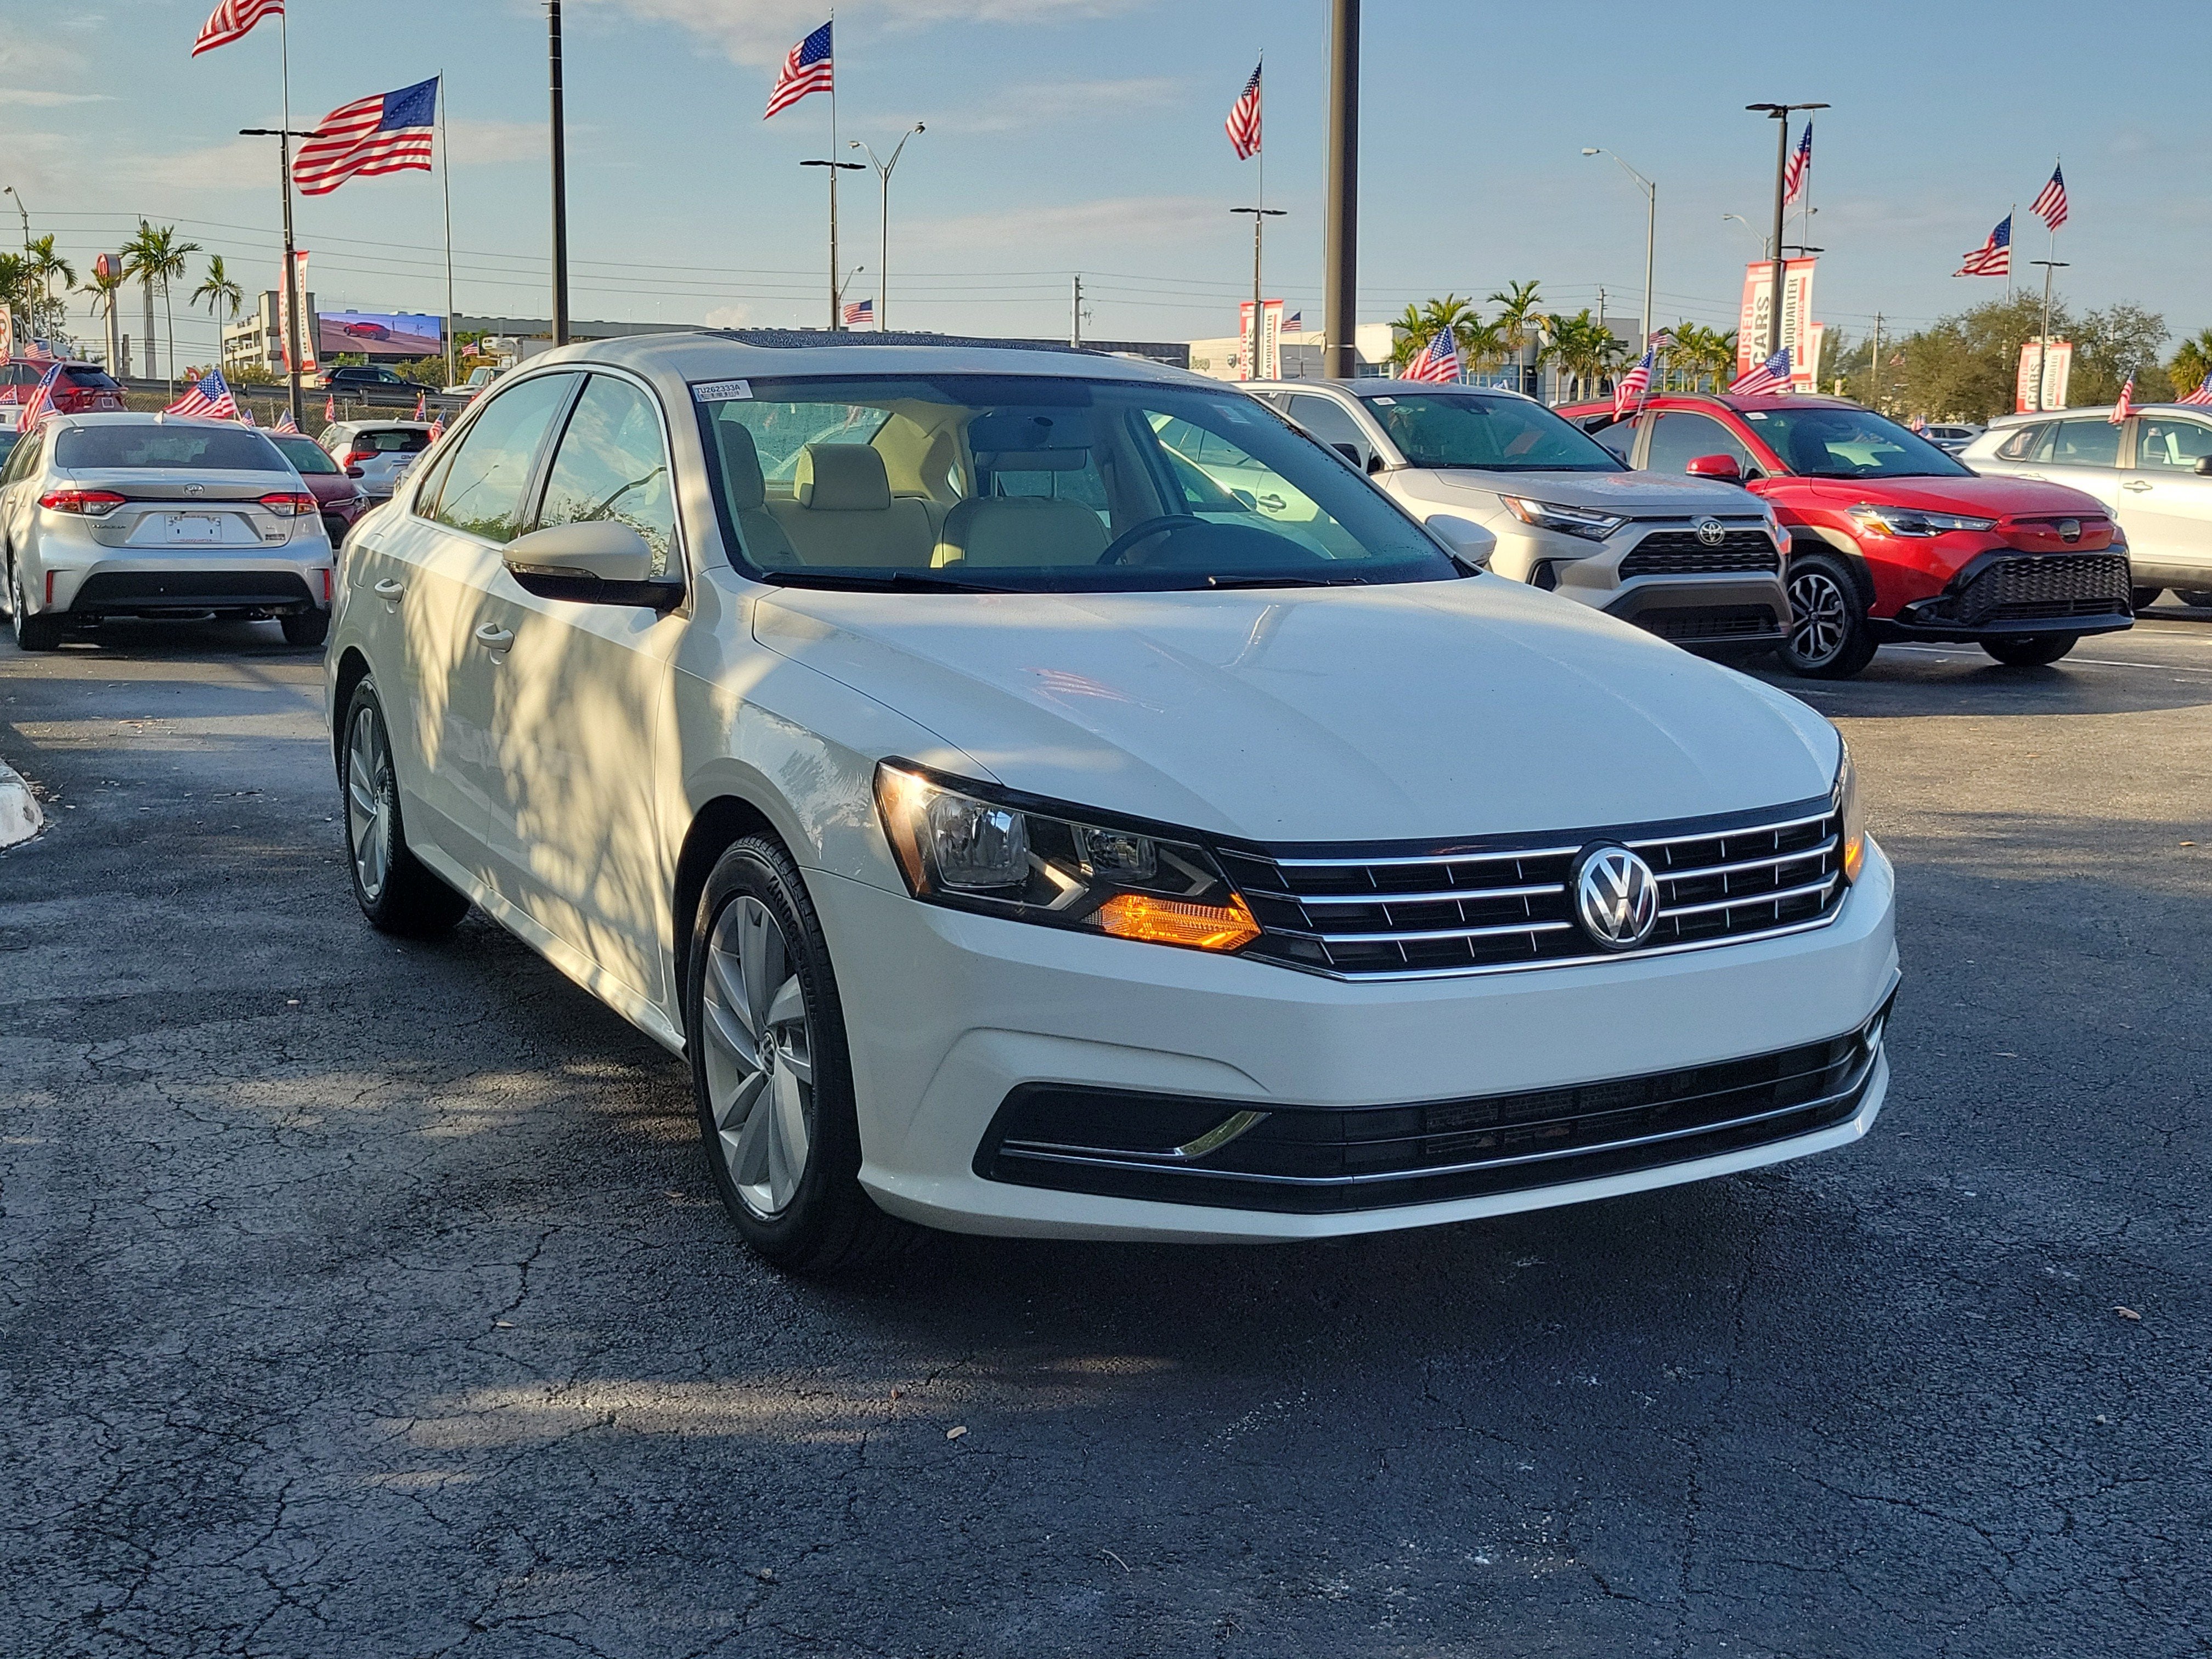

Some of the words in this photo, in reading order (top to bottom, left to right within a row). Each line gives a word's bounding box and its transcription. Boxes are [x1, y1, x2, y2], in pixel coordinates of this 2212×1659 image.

[1741, 306, 1754, 357] USED
[1753, 296, 1769, 366] CARS
[695, 384, 741, 393] TU262333A
